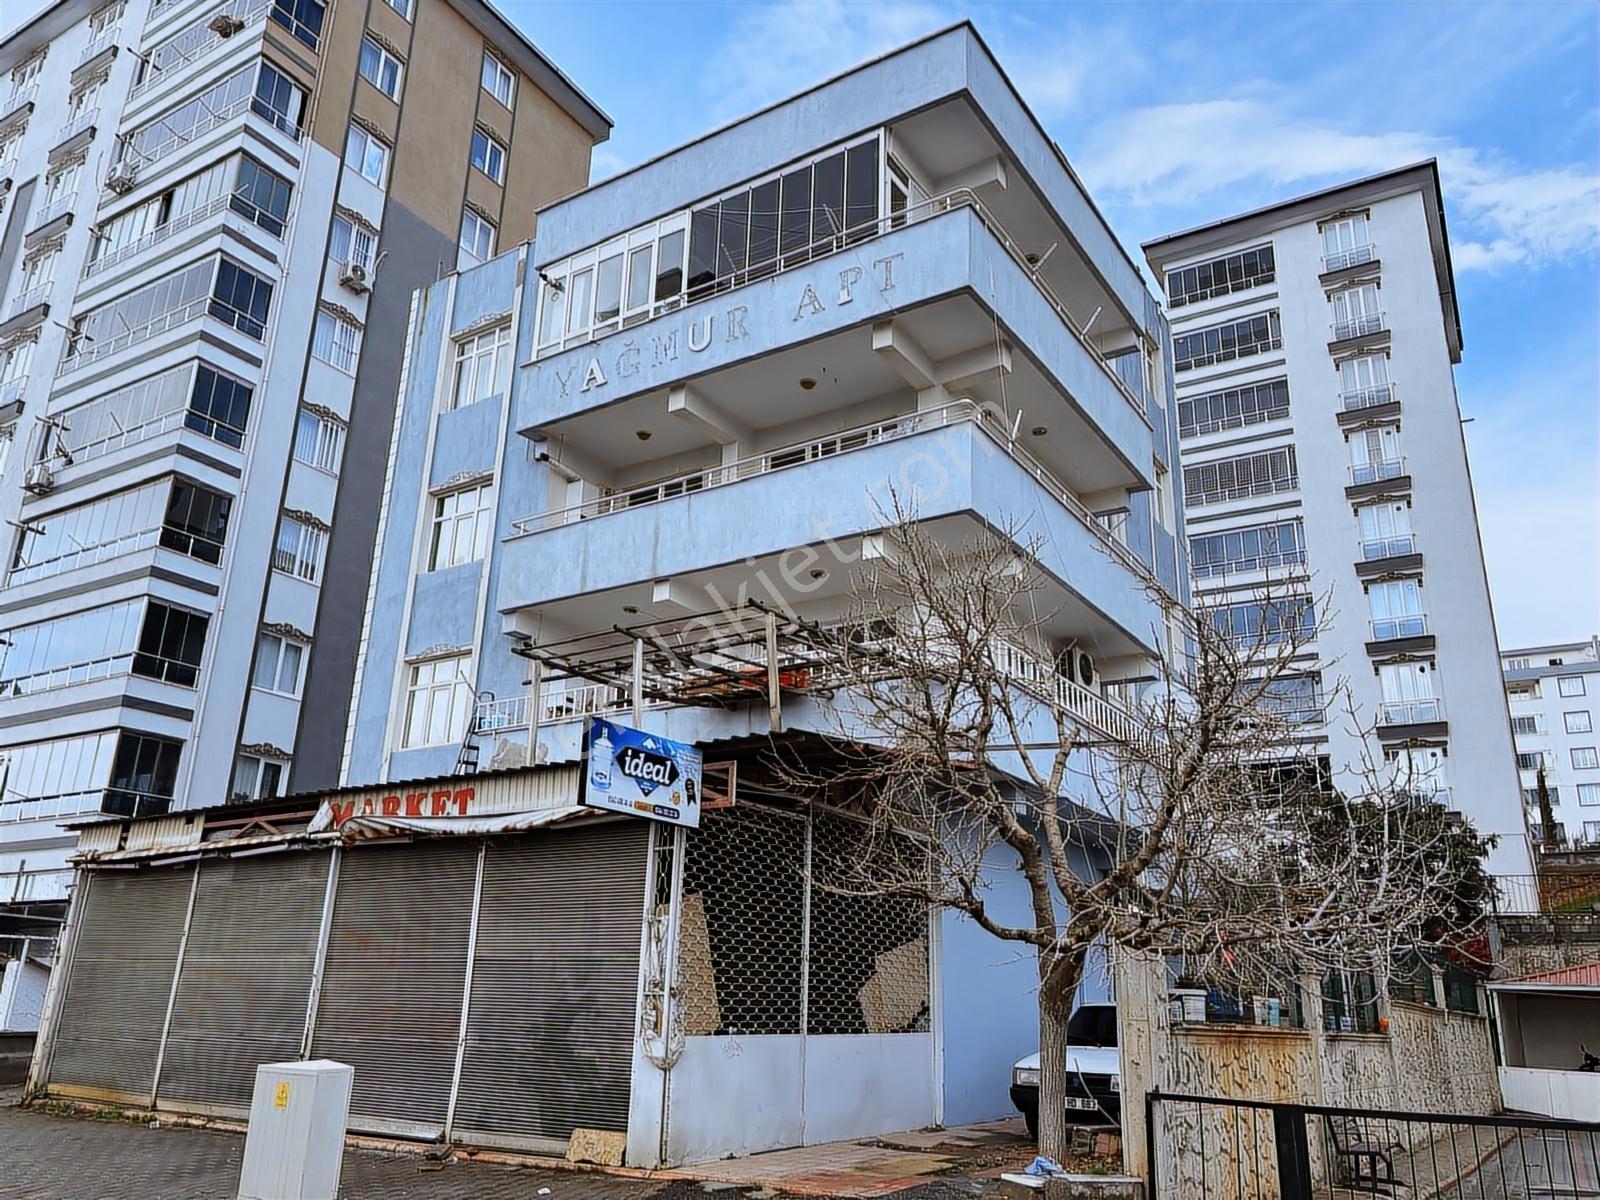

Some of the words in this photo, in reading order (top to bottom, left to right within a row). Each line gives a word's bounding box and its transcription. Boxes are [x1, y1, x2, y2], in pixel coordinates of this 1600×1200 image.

[554, 304, 749, 398] YAĞMUR
[793, 251, 904, 322] APT
[623, 749, 672, 785] ideal
[330, 787, 475, 827] MARKET
